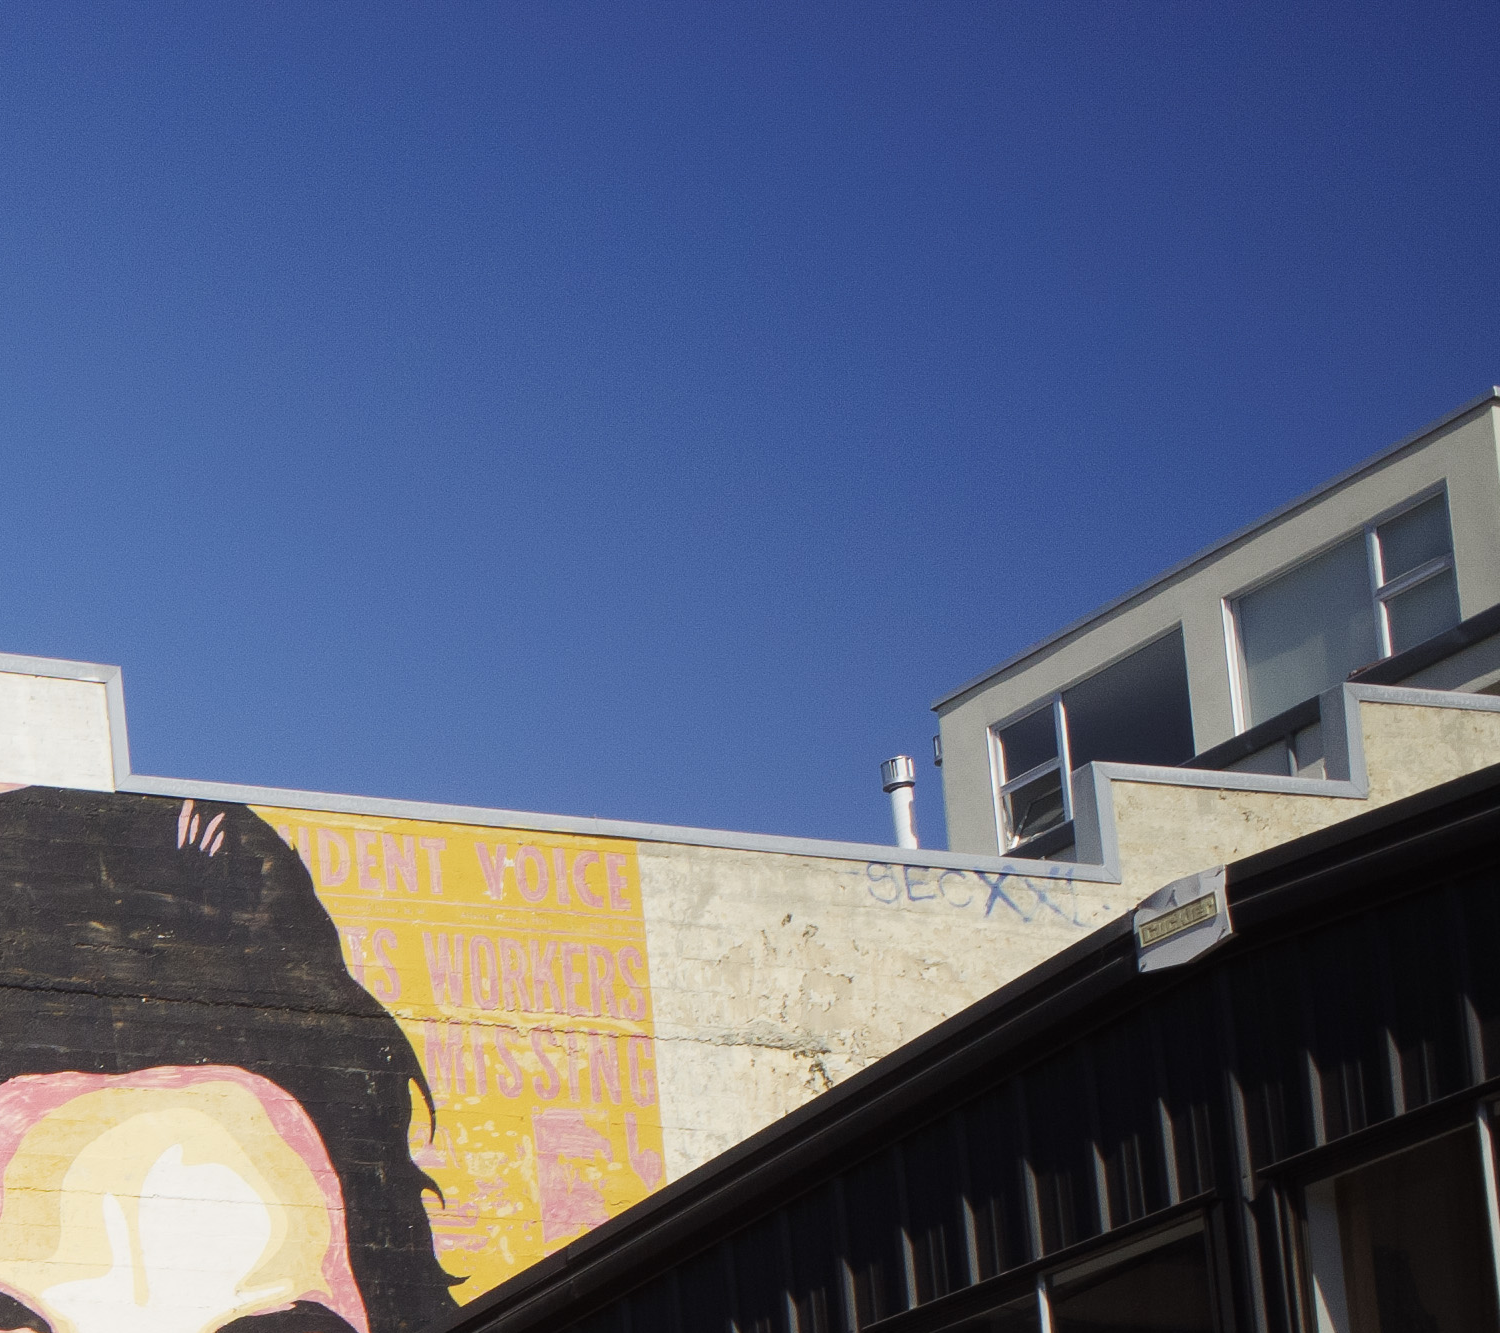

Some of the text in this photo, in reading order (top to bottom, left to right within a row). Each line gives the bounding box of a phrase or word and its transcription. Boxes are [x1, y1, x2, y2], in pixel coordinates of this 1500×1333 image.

[474, 842, 632, 911] VOICE
[422, 932, 649, 1022] WORKERS
[422, 1018, 656, 1107] MISSING
